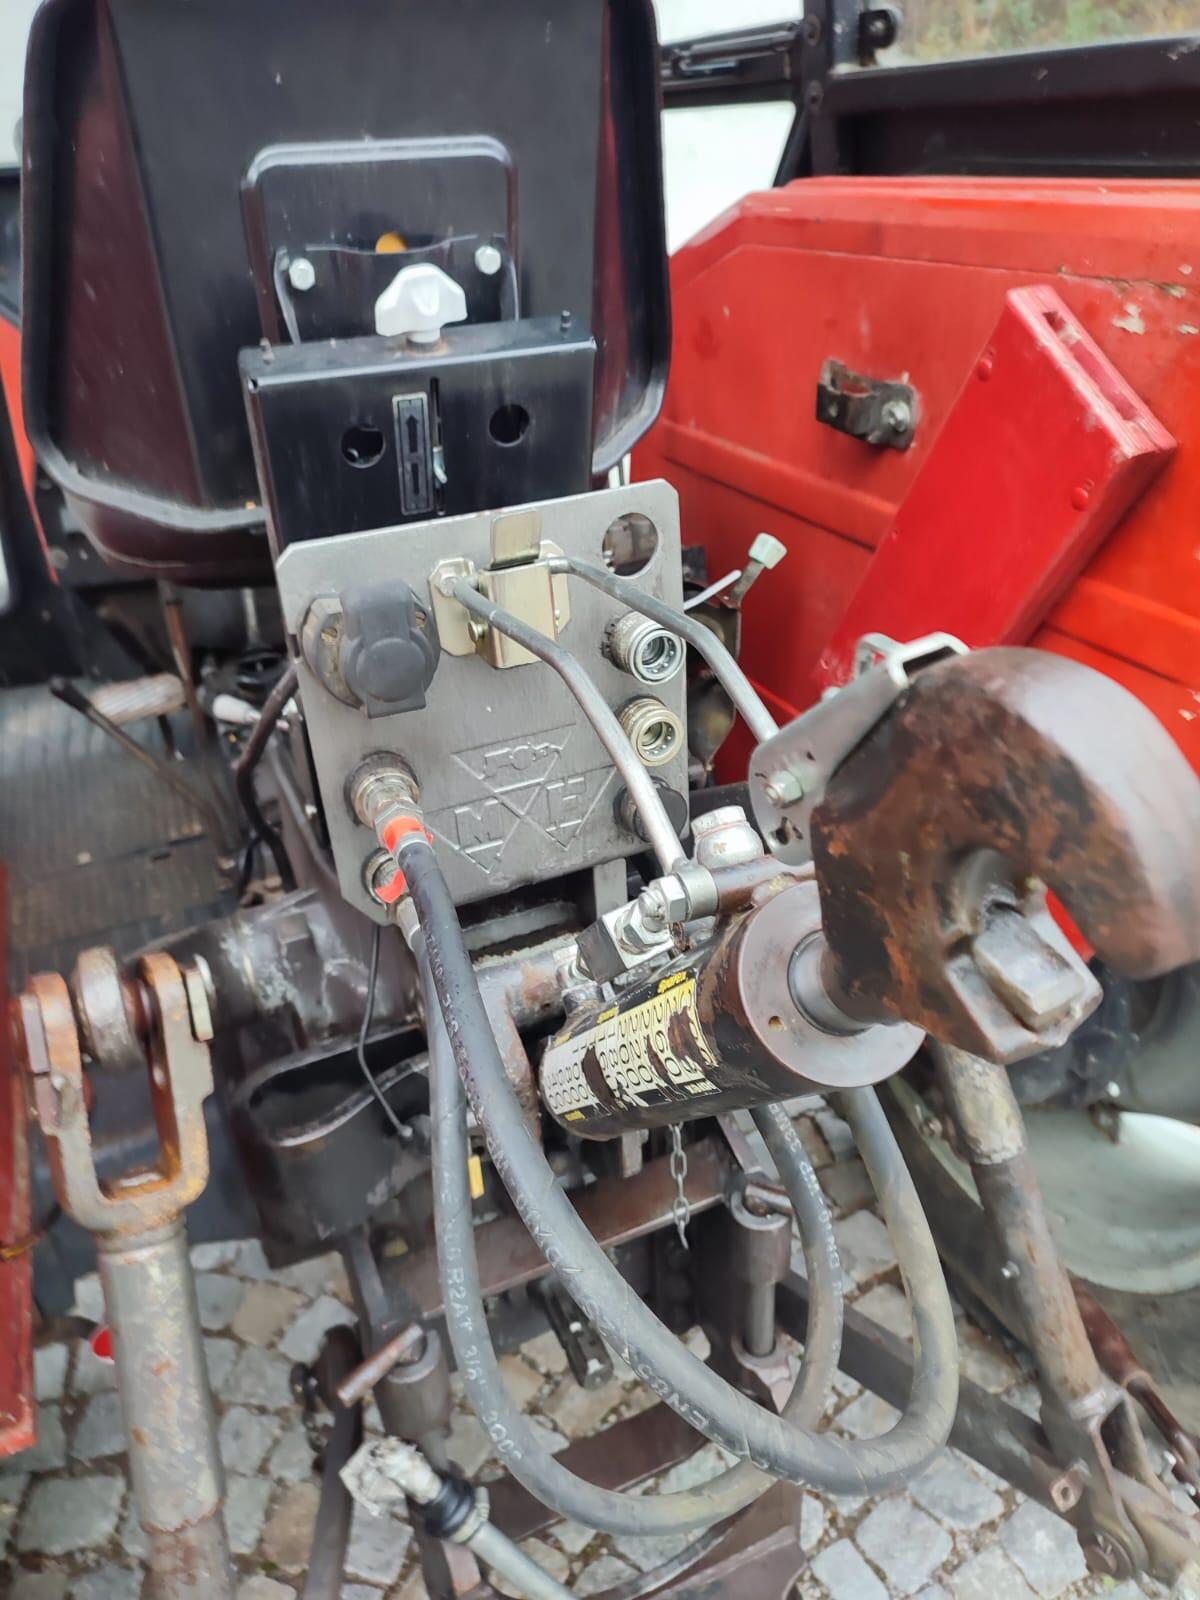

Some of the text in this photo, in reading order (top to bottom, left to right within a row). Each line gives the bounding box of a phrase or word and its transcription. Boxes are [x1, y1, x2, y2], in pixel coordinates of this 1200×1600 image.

[618, 1020, 638, 1086] 200
[630, 1013, 654, 1084] 220
[653, 1003, 682, 1077] 260
